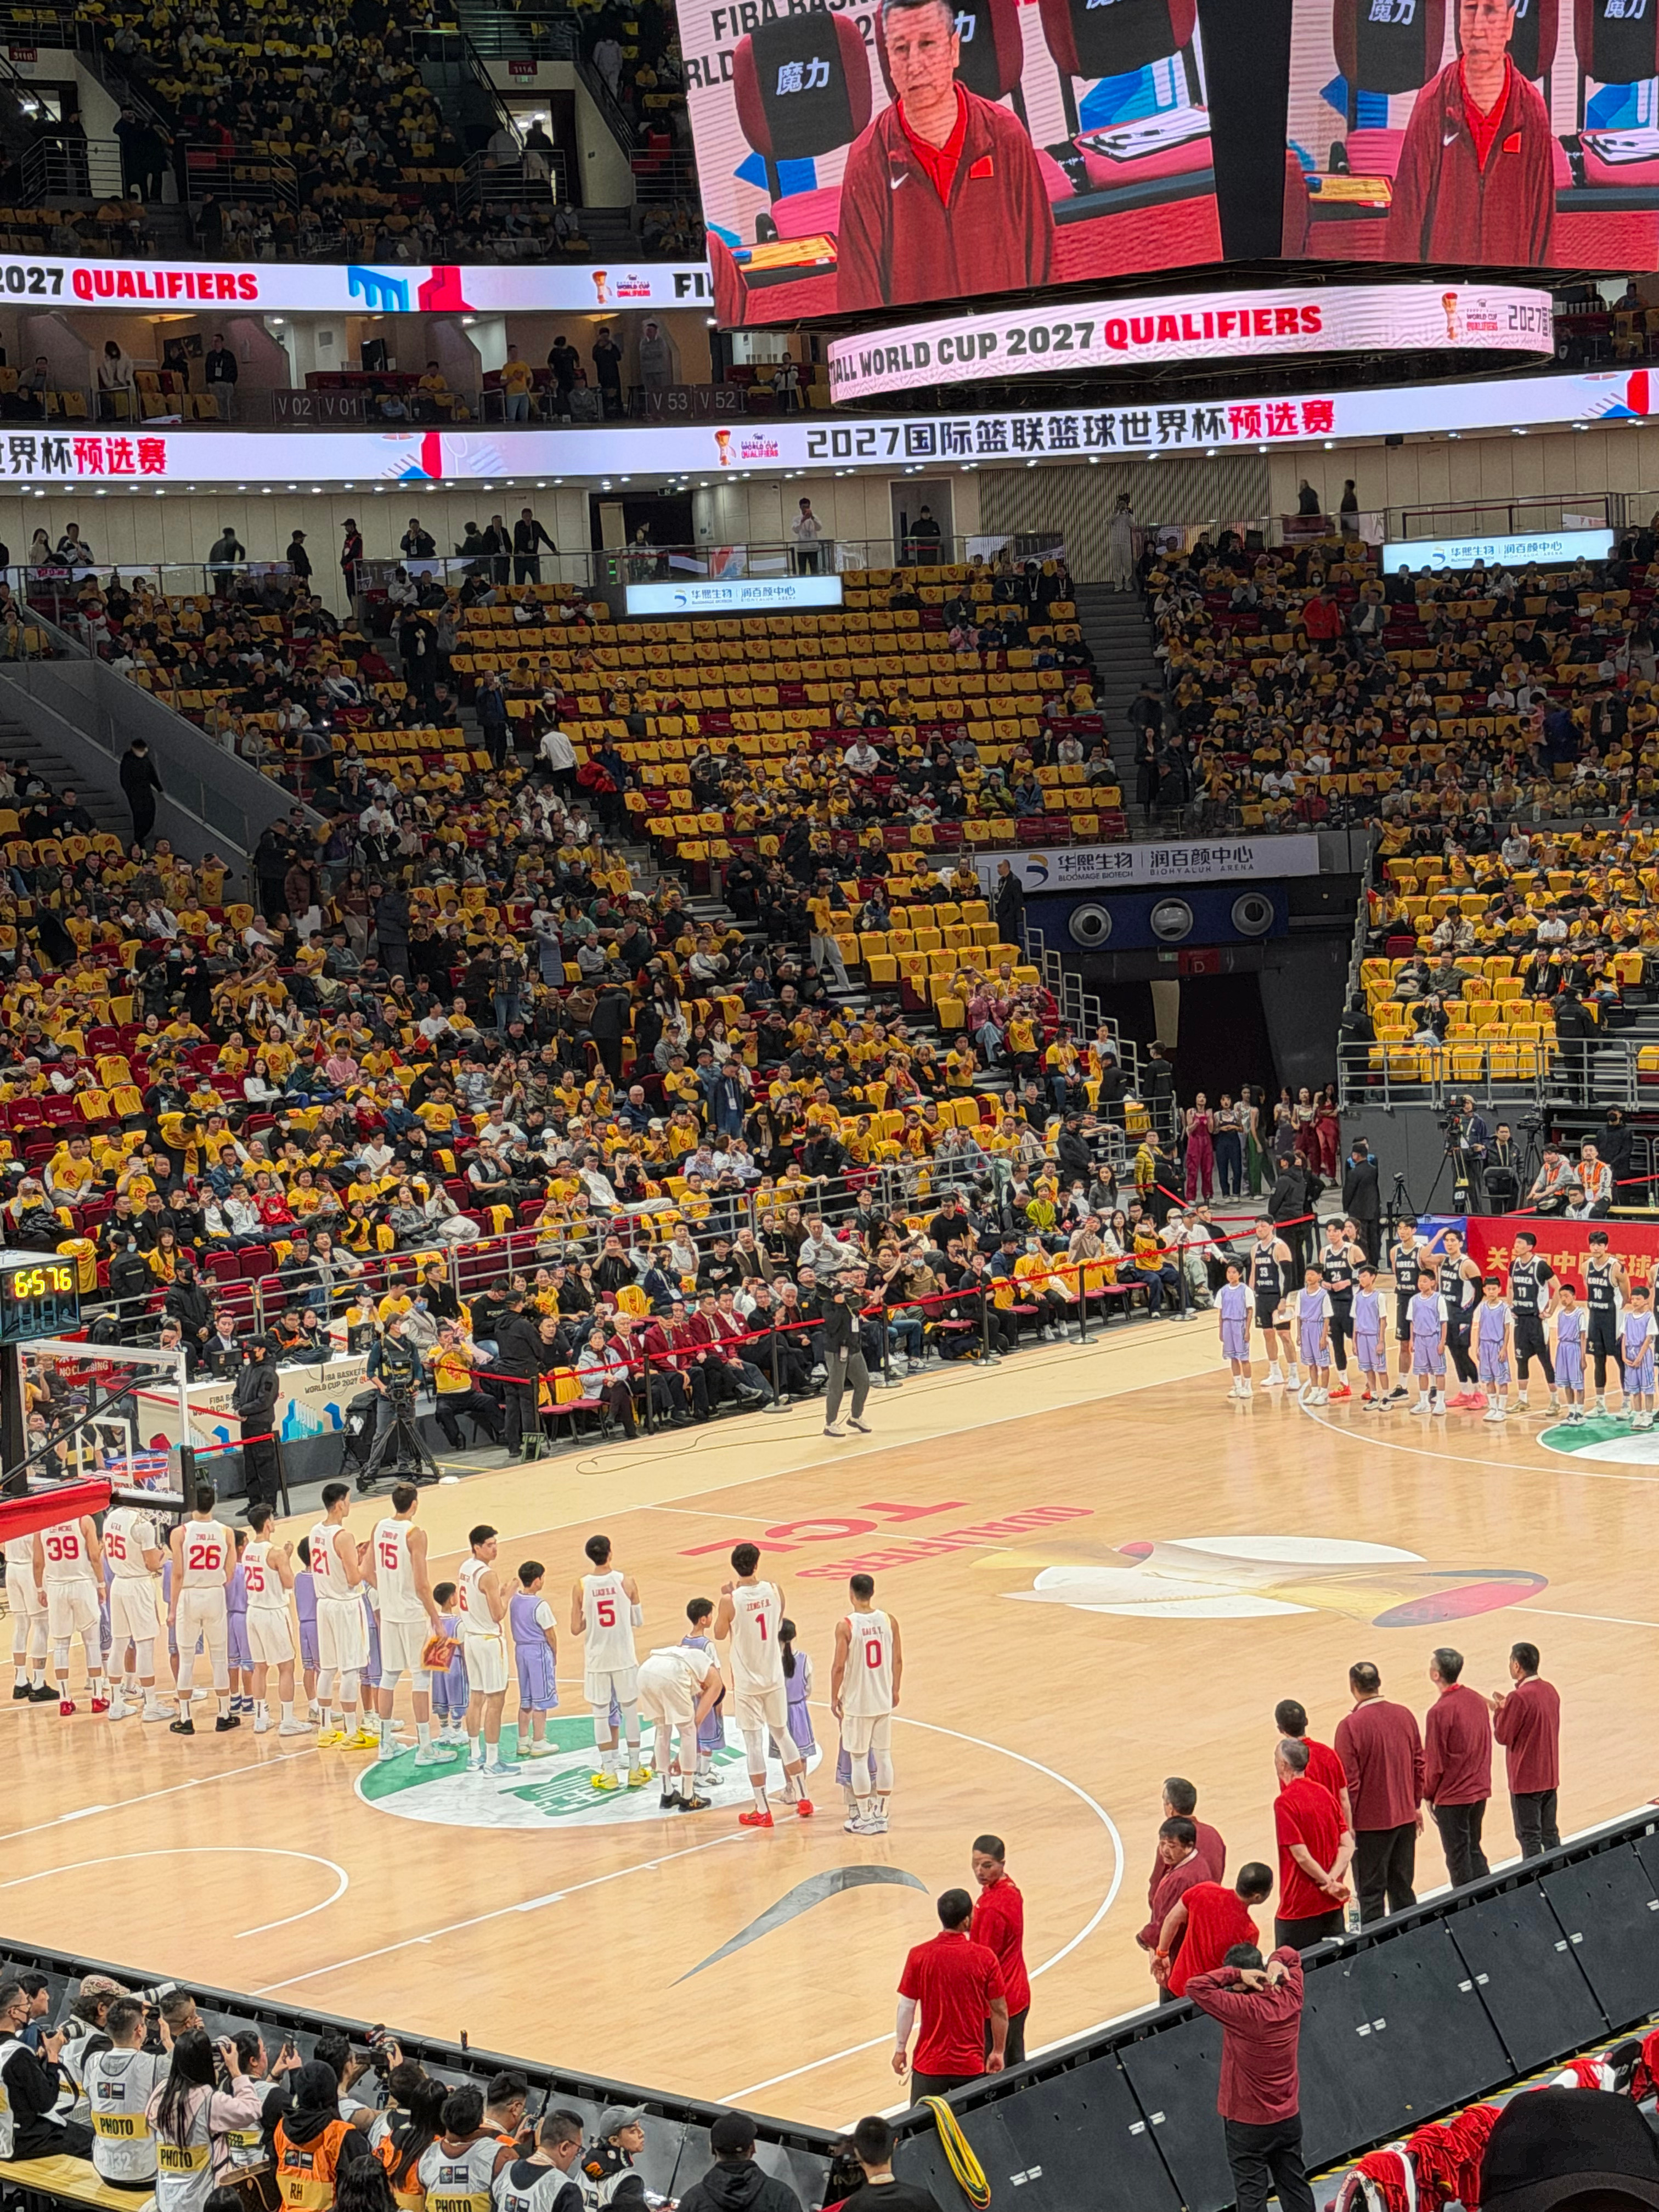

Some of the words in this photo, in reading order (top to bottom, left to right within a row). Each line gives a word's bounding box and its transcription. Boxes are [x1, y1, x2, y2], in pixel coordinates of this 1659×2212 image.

[954, 10, 975, 43] 力
[776, 57, 830, 95] 魔力
[0, 266, 64, 295] 027
[73, 268, 258, 302] QUALIFIERS
[859, 341, 930, 379] WORLD
[938, 332, 997, 365] CUP
[1006, 322, 1094, 356] 2027
[1104, 306, 1322, 351] QUALIFIERS
[278, 398, 287, 415] V
[292, 397, 312, 416] 02
[325, 398, 335, 415] V
[339, 397, 358, 416] 01
[653, 393, 663, 410] V
[668, 393, 687, 410] 53
[700, 392, 709, 409] V
[715, 391, 736, 409] 52
[807, 399, 1335, 459] 2027国际篮联篮球世界杯预选赛
[0, 436, 168, 475] 界杯预选赛
[1058, 851, 1132, 873] 华熙生物
[1150, 845, 1254, 868] 润百颜中心
[1058, 872, 1101, 882] BLOOMAGE
[1102, 871, 1133, 879] BIOTECH
[1220, 864, 1254, 872] ARENA
[1194, 961, 1205, 973] D
[1330, 1271, 1341, 1282] 26
[1401, 1271, 1410, 1281] 23
[1442, 1280, 1451, 1291] 12
[1588, 1277, 1608, 1286] KOREA
[1517, 1286, 1526, 1297] 11
[1593, 1288, 1602, 1299] 10
[325, 1372, 336, 1381] IBA
[337, 1367, 366, 1379] BASKETB
[304, 1383, 326, 1394] WORLD
[328, 1380, 341, 1390] CUP
[209, 1395, 224, 1404] FIBA
[676, 1502, 971, 1556] TCL
[46, 1536, 79, 1561] 39
[105, 1532, 126, 1561] 35
[794, 1505, 1095, 1581] QUALIFIERS
[189, 1545, 222, 1570] 26
[312, 1548, 330, 1576] 21
[379, 1542, 398, 1570] 15
[245, 1566, 264, 1592] 25
[597, 1600, 616, 1627] 5
[755, 1613, 767, 1641] 1
[866, 1639, 882, 1669] 0
[100, 2117, 133, 2135] PHOTO
[160, 2148, 193, 2168] PHOTO
[435, 2198, 472, 2212] PHOTO
